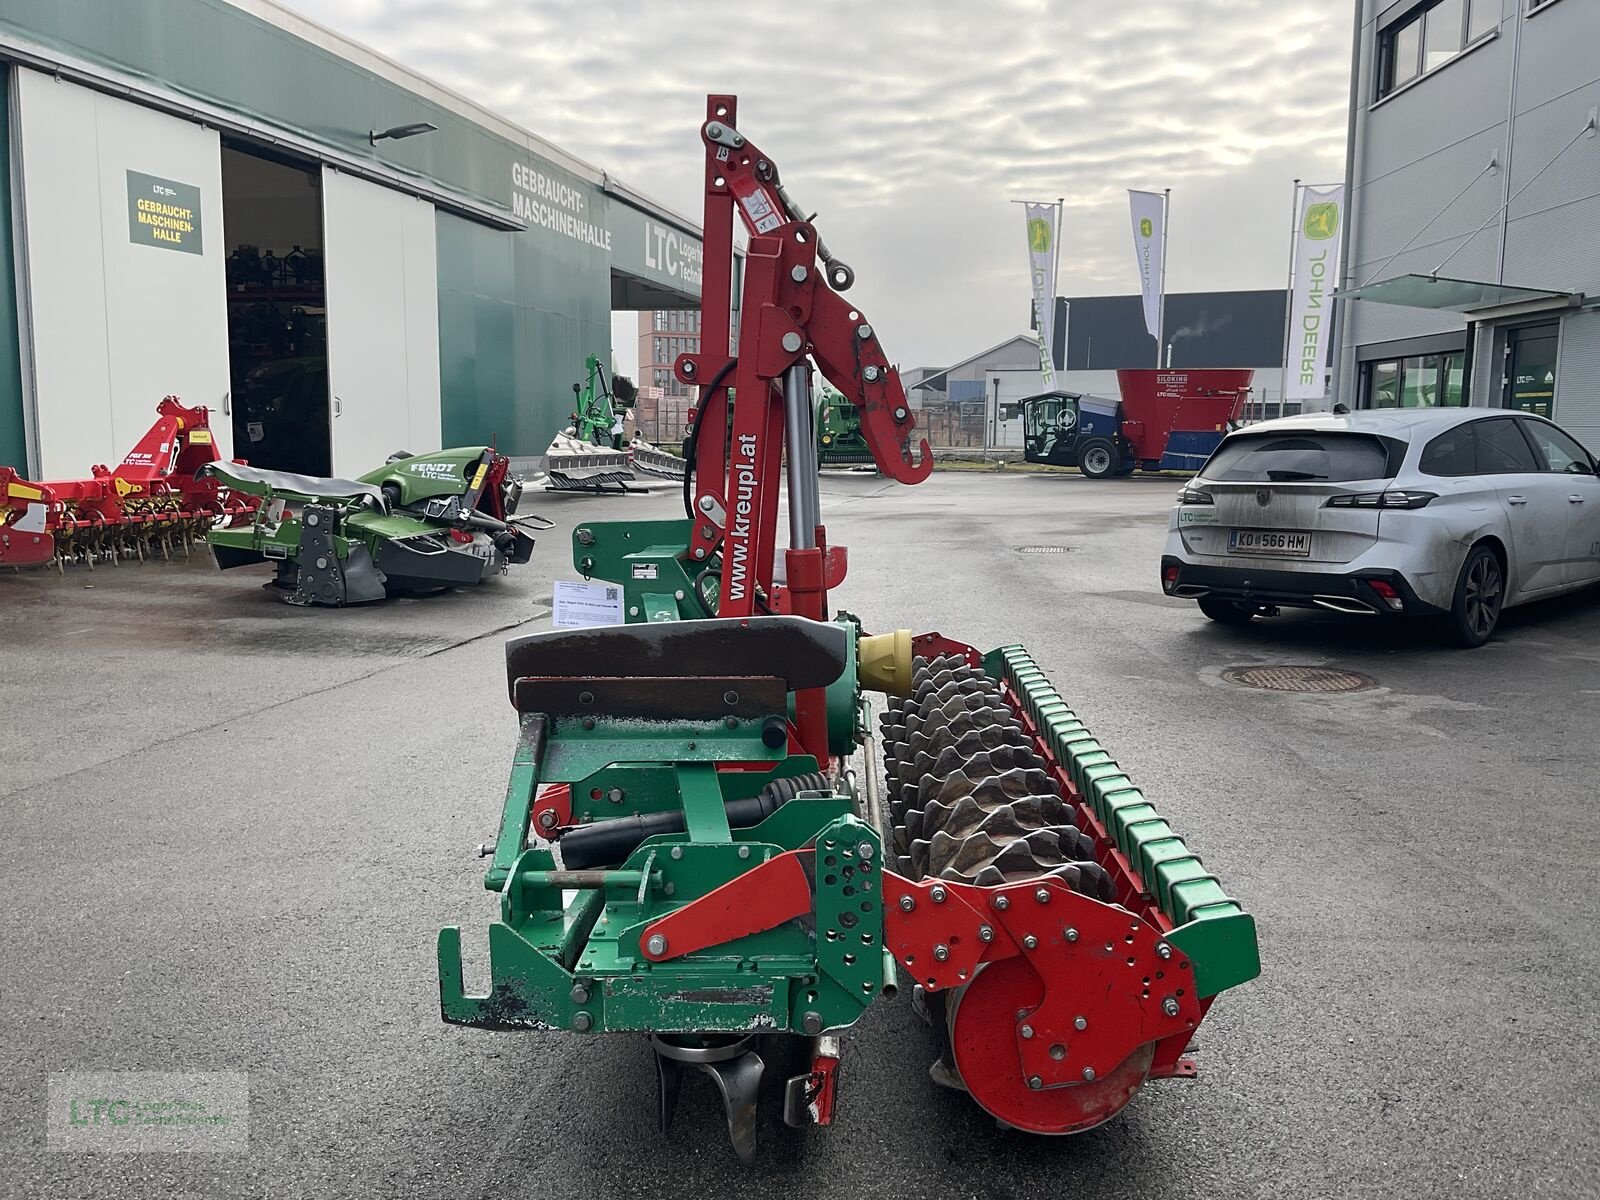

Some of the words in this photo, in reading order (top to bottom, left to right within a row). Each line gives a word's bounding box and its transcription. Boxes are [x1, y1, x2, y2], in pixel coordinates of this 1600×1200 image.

[153, 185, 165, 195] LTC
[512, 162, 584, 213] GEBRAUCHT-
[137, 198, 194, 220] GEBRAUCHT-
[138, 211, 194, 232] MASCHINEN-
[512, 192, 611, 251] MASCHINENHALLE
[153, 227, 181, 243] HALLE
[645, 222, 678, 276] LTC
[410, 463, 457, 472] FENDT
[421, 471, 437, 479] LTC
[730, 433, 758, 600] www.kreupl.at
[1180, 512, 1193, 522] LTC
[1262, 534, 1285, 548] 566
[1287, 535, 1305, 549] HM
